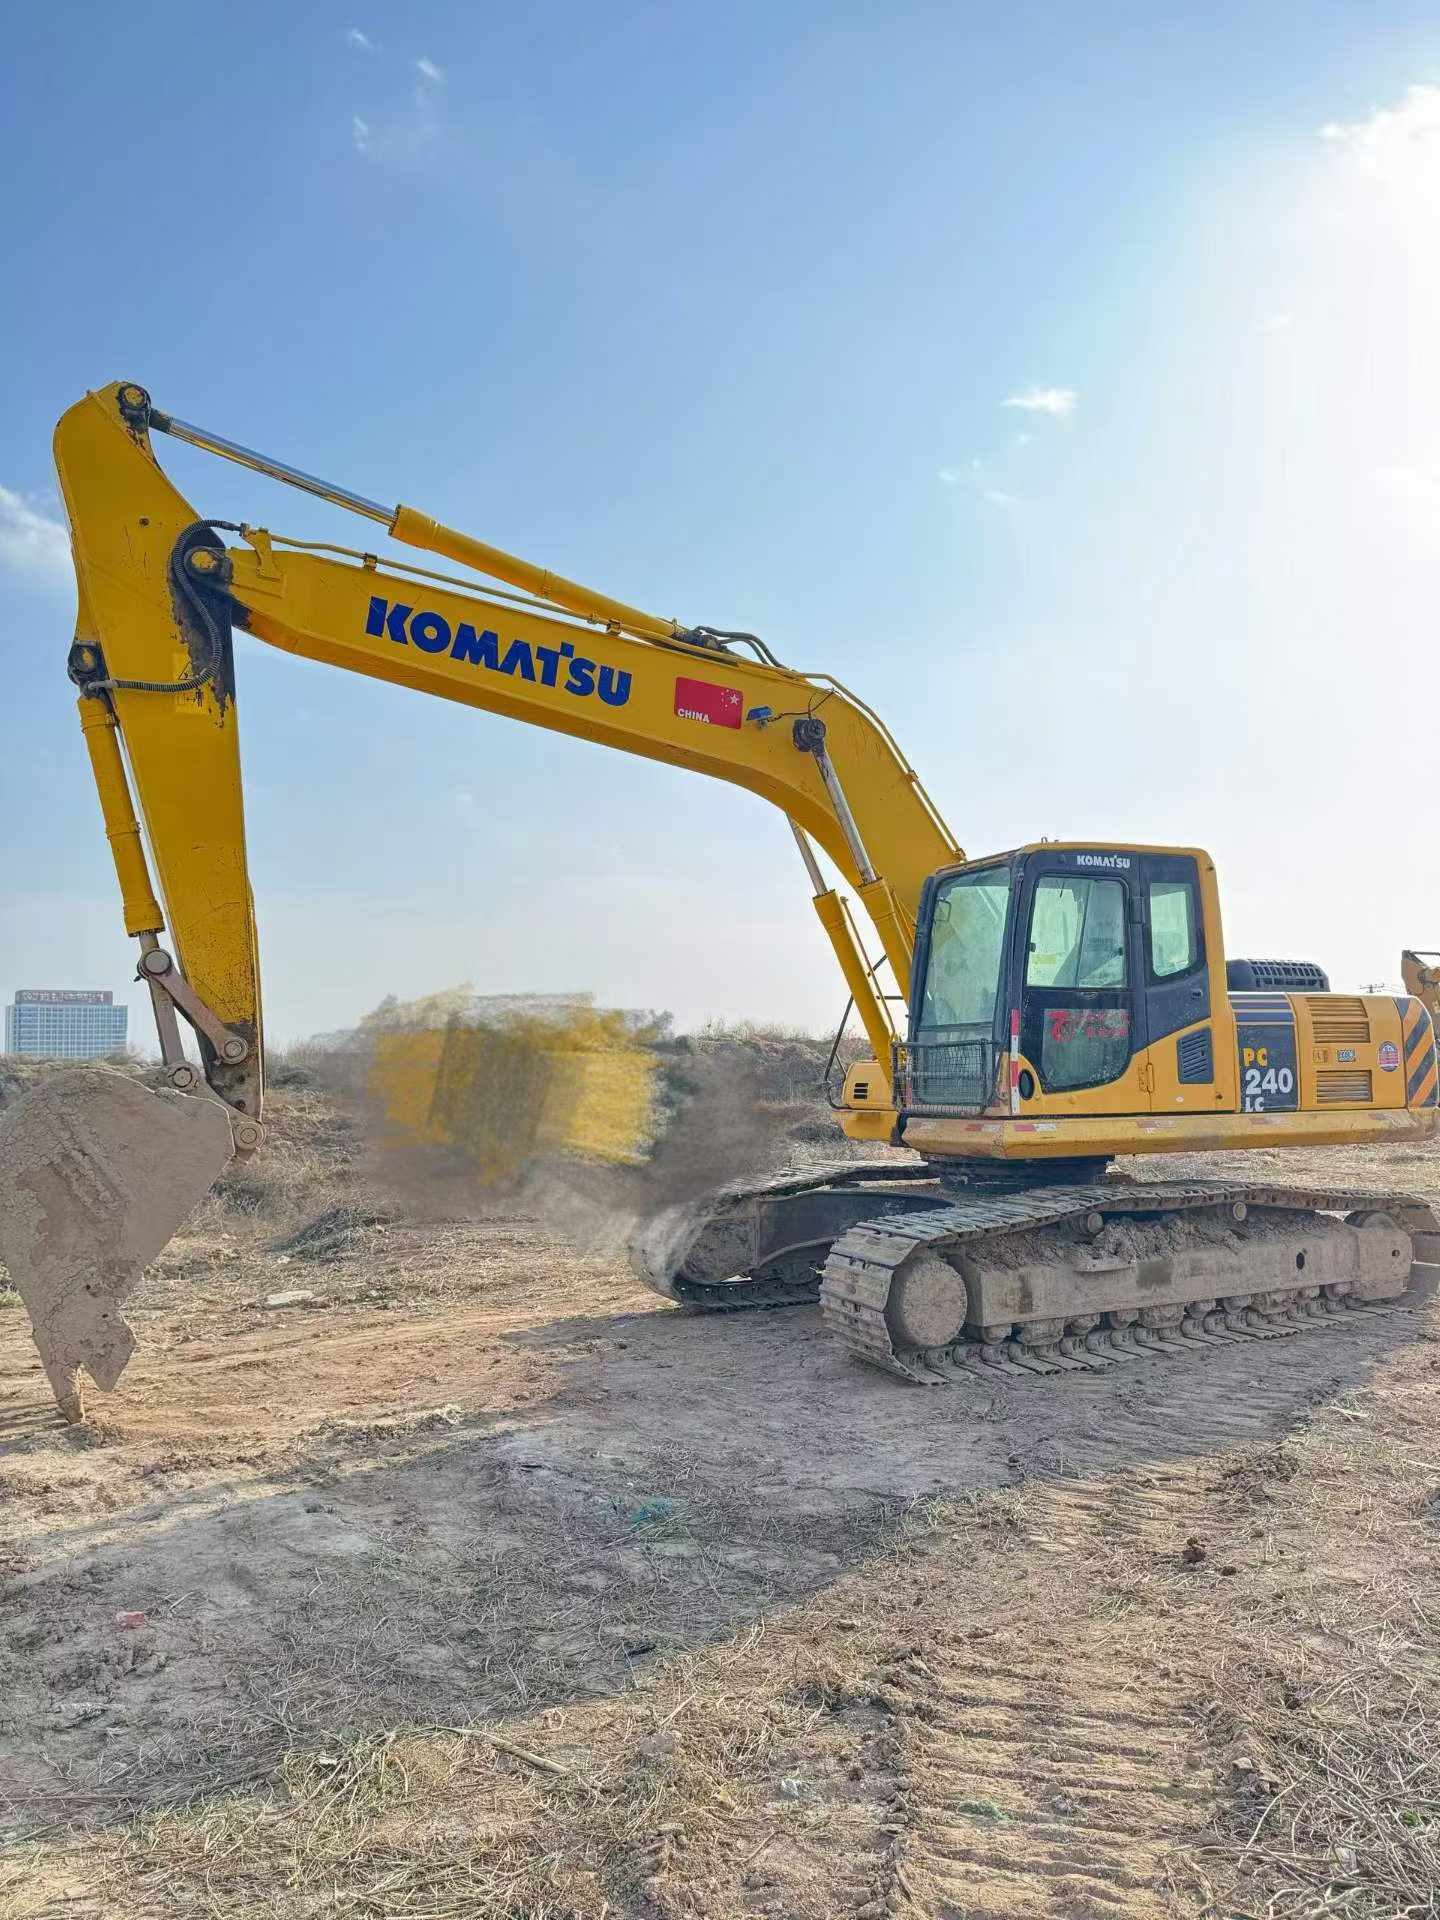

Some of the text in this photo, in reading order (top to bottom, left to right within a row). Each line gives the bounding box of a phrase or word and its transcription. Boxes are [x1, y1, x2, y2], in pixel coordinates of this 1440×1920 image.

[365, 596, 632, 706] KOMATSU
[678, 708, 710, 723] CHINA
[1077, 855, 1131, 868] KOMATSU
[1243, 1047, 1268, 1066] PC
[1245, 1068, 1293, 1095] 240
